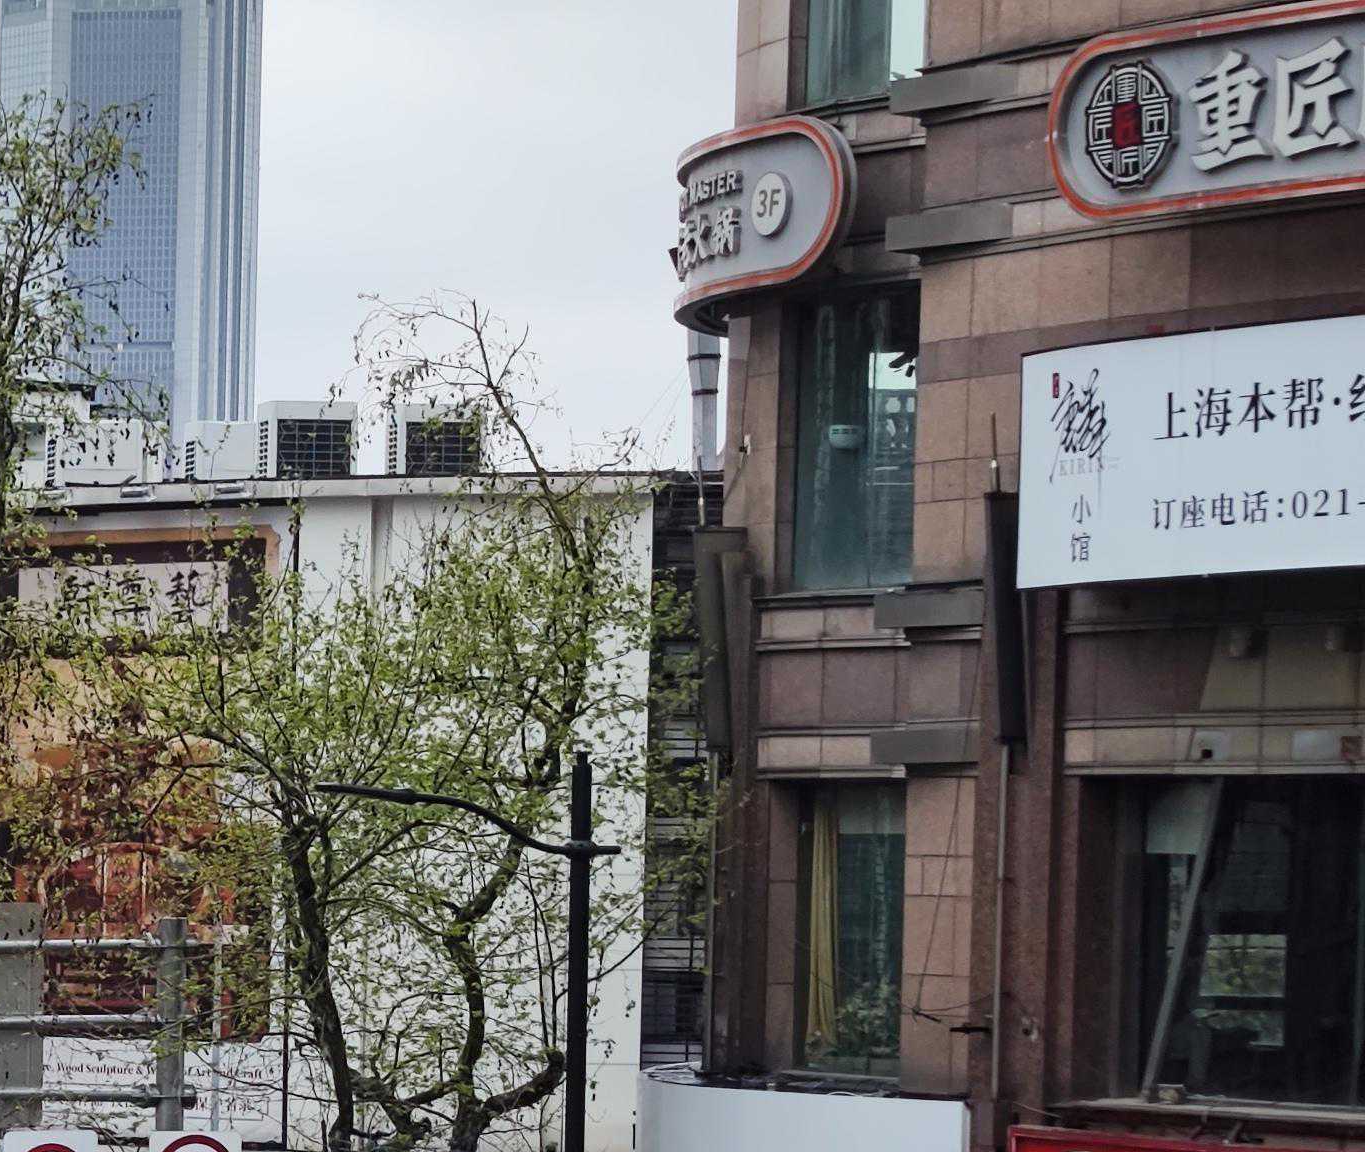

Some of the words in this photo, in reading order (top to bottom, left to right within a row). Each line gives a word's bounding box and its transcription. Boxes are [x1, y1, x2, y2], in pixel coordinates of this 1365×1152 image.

[1188, 36, 1365, 173] 重匠
[755, 188, 782, 218] 3F
[1070, 494, 1093, 562] 小馆
[57, 1062, 84, 1074] Wood
[85, 1062, 135, 1076] Sculpture
[136, 1065, 143, 1075] &
